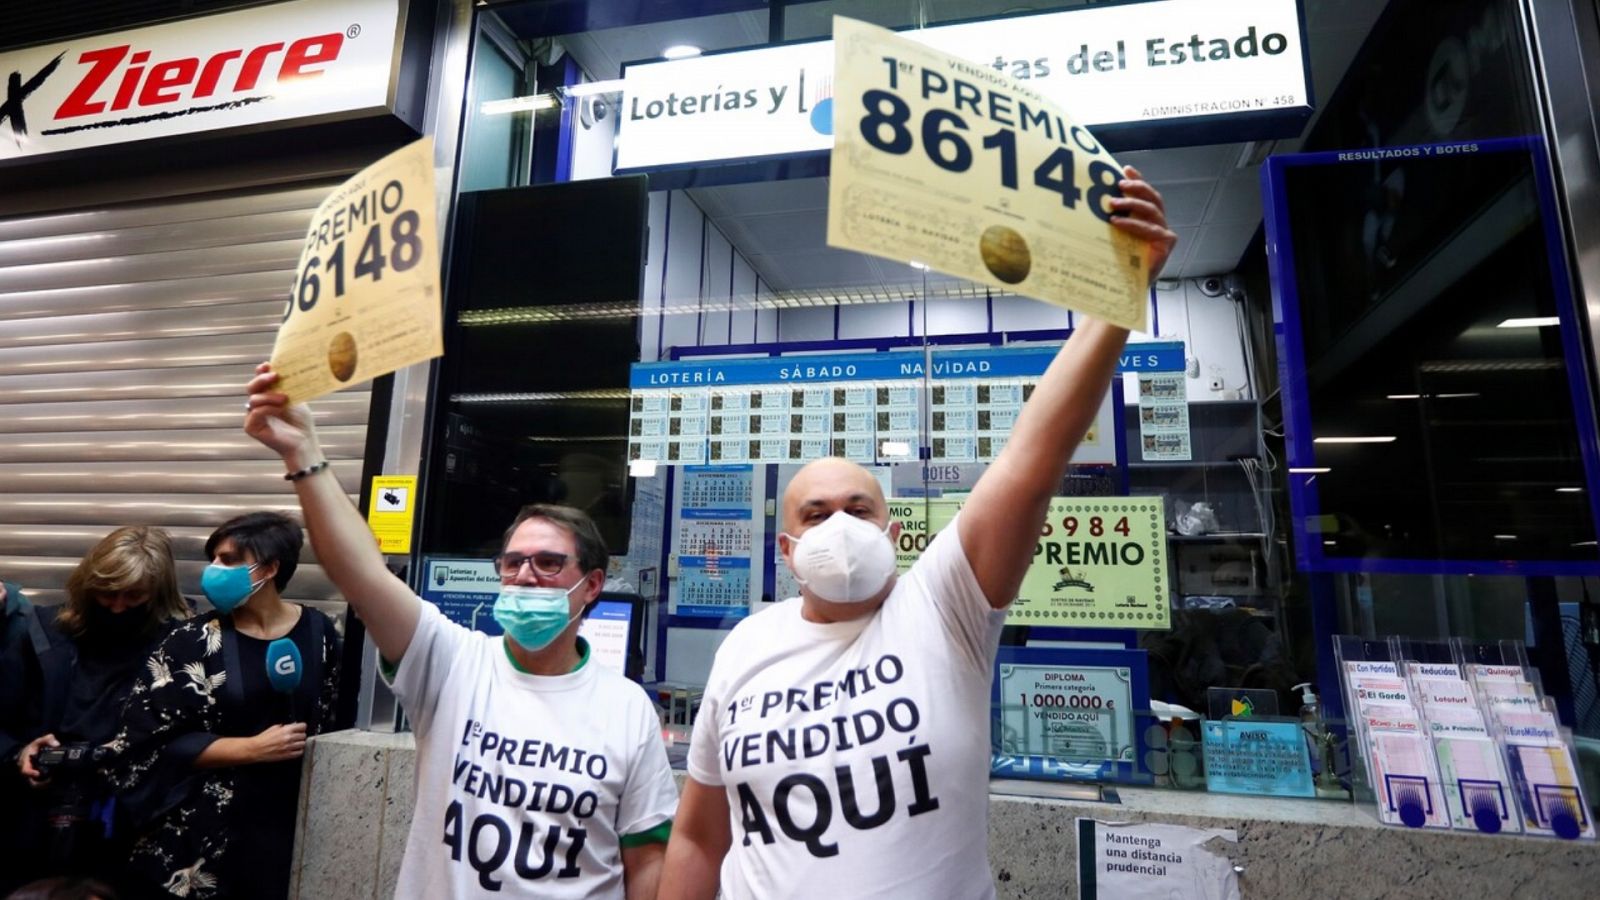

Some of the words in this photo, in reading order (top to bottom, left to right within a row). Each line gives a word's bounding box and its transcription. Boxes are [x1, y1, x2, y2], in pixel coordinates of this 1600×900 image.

[53, 32, 345, 120] Zierre
[630, 84, 758, 121] Loterías
[767, 85, 788, 114] y
[1066, 40, 1126, 75] del
[1146, 26, 1288, 67] Estado
[948, 60, 1008, 88] VENDIDO
[882, 56, 914, 89] 1er
[921, 68, 1101, 155] PREMIO
[1273, 95, 1296, 106] 458
[859, 88, 1128, 225] 86148
[1338, 148, 1420, 161] RESULTADOS
[1423, 147, 1432, 155] Y
[1436, 143, 1479, 155] BOTES
[651, 367, 725, 385] LOTERÍA
[780, 361, 857, 380] SÁBADO
[922, 466, 960, 481] BOTES
[760, 654, 904, 719] PREMIO
[1034, 682, 1062, 690] Primera
[1044, 673, 1085, 682] DIPLOMA
[1020, 693, 1102, 709] 1.000.000
[1106, 700, 1114, 710] €
[1368, 691, 1376, 699] El
[1378, 692, 1406, 700] Gordo
[1034, 711, 1075, 721] VENDIDO
[724, 697, 920, 771] VENDIDO
[480, 731, 608, 780] PREMIO
[452, 753, 599, 819] VENDIDO
[737, 735, 940, 858] AQUÍ
[1105, 832, 1162, 849] Mantenga
[1106, 849, 1127, 858] una
[1131, 850, 1182, 864] distancia
[1106, 862, 1167, 876] prudencial
